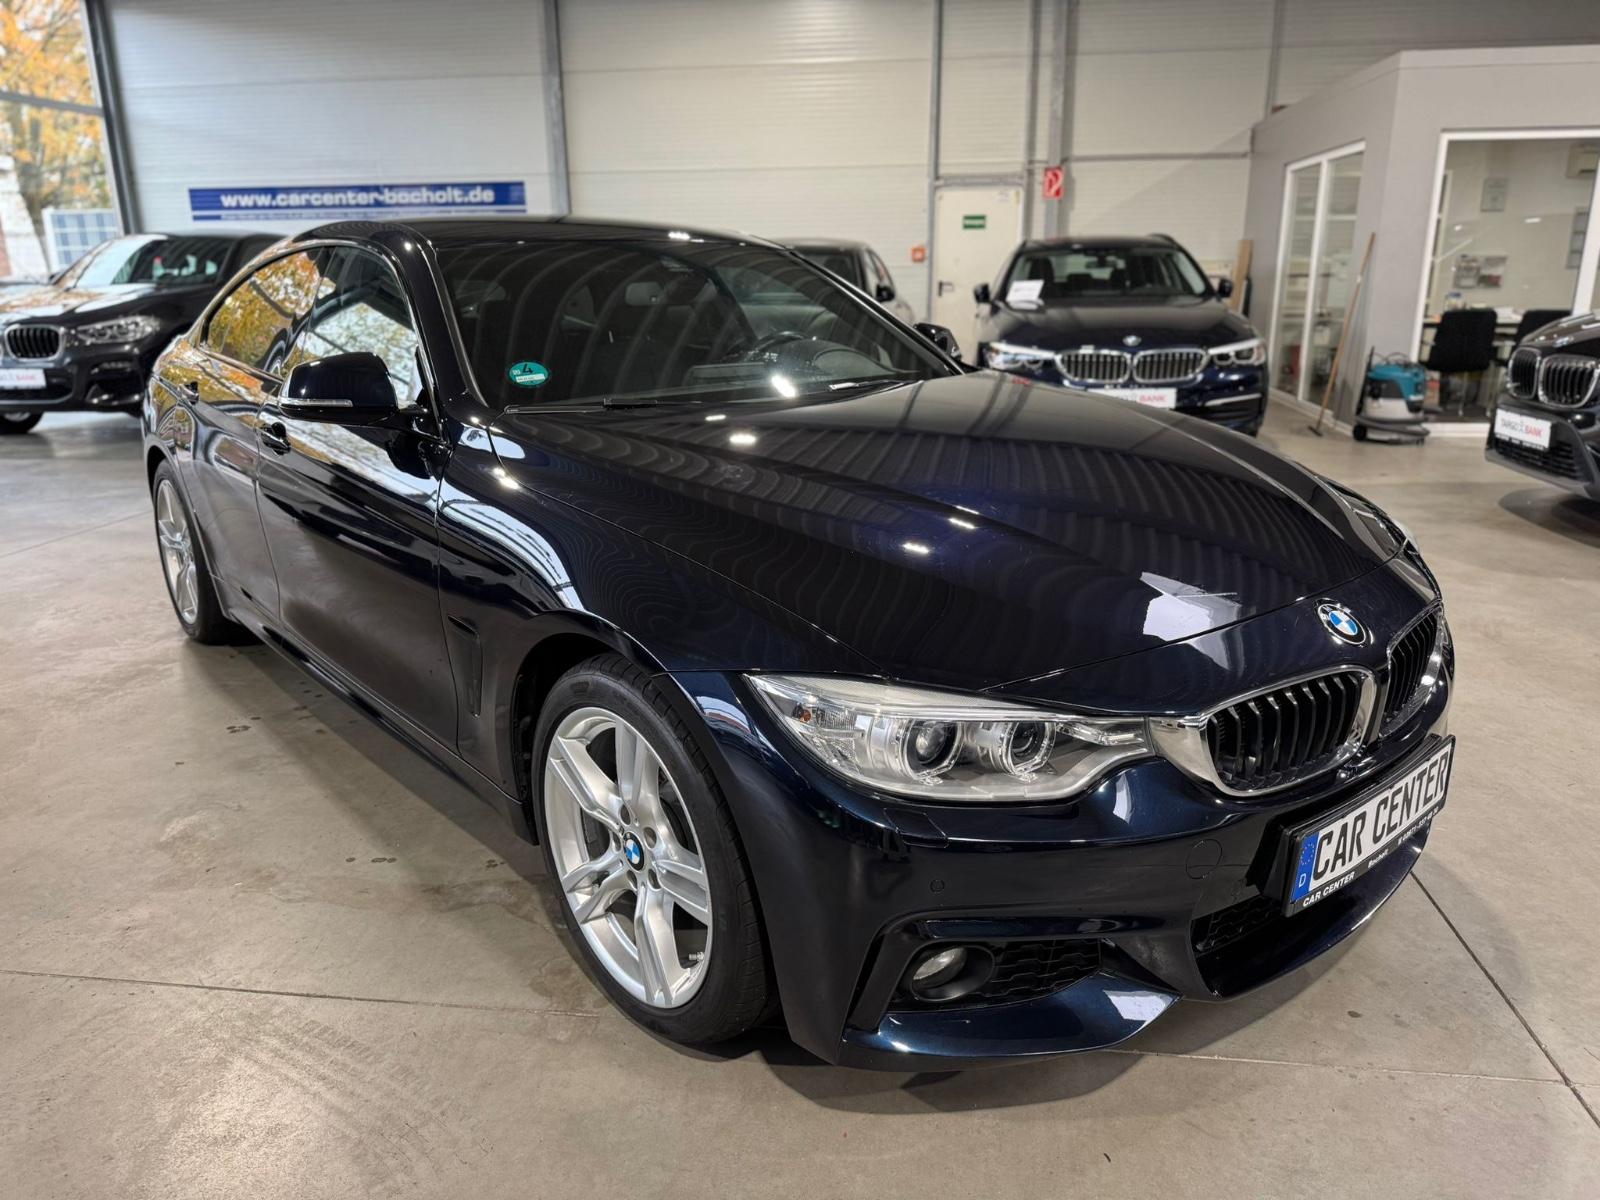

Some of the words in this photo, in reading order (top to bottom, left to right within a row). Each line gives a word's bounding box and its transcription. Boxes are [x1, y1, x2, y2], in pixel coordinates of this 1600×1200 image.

[220, 186, 495, 208] www.carcenter-bocholt.de
[522, 363, 533, 373] 4
[1313, 811, 1367, 881] CAR
[1372, 751, 1449, 845] CENTER
[1298, 873, 1307, 888] D
[1302, 891, 1321, 907] CAR
[1322, 871, 1355, 896] CENTER
